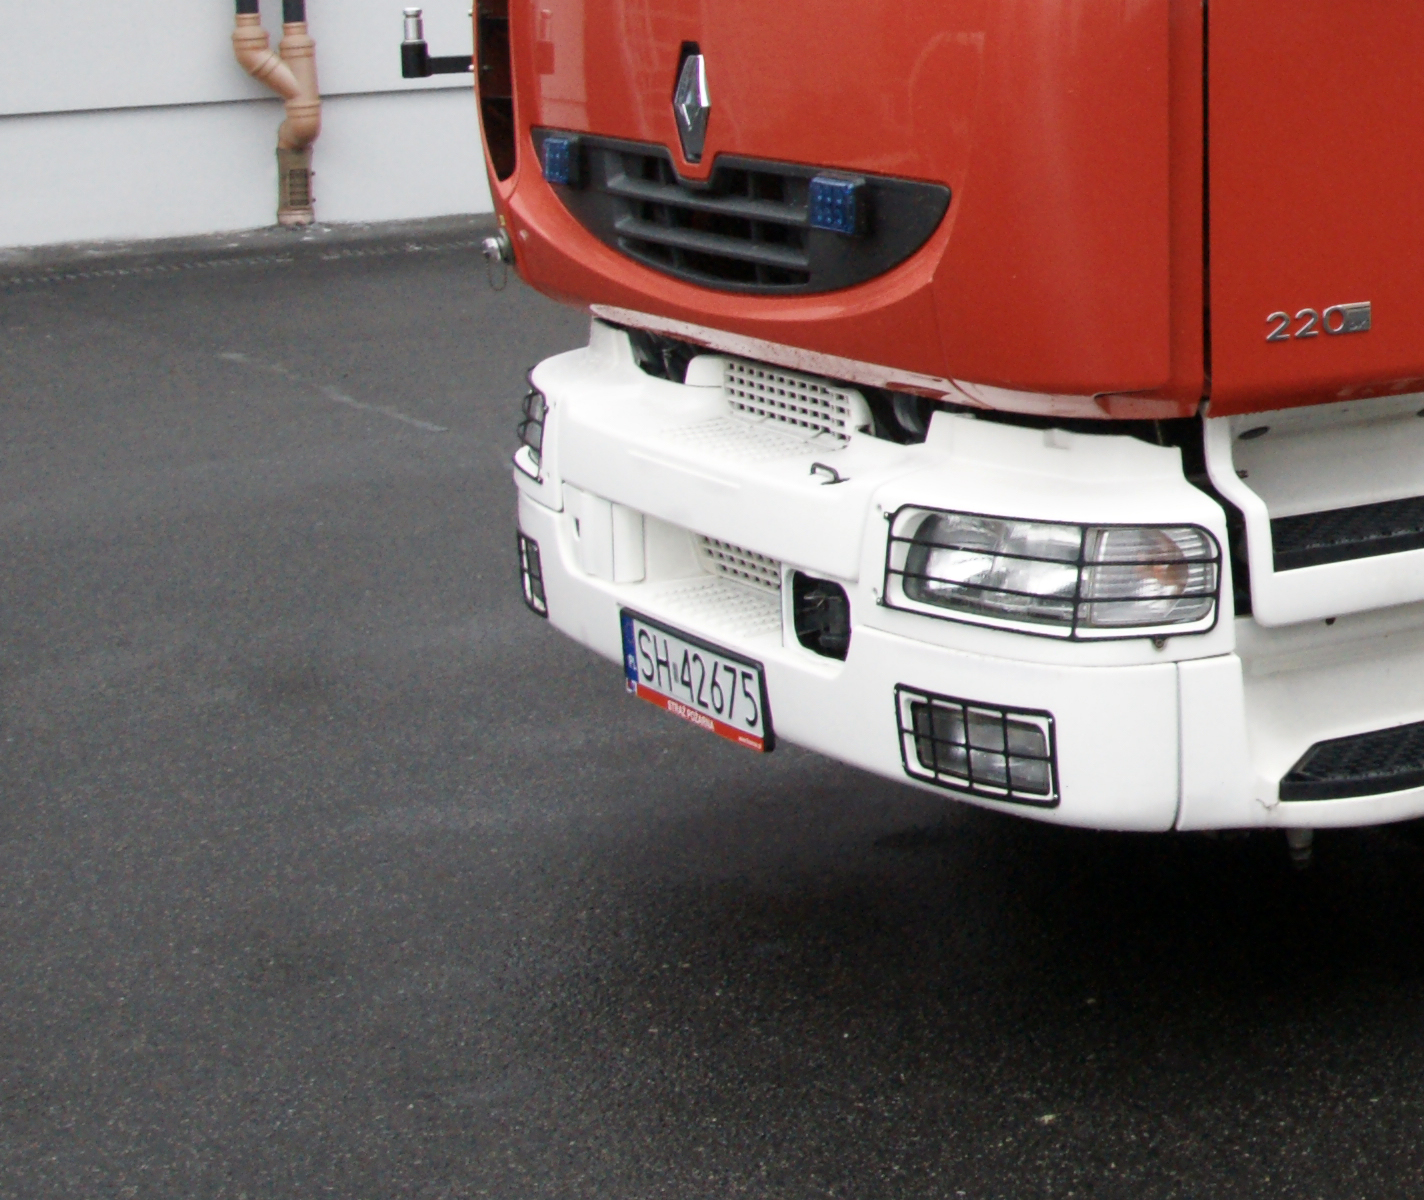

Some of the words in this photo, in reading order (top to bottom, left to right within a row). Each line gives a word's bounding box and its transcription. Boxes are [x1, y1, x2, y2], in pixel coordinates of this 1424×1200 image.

[1266, 304, 1346, 341] 220
[638, 629, 673, 692] SH
[681, 649, 759, 727] 42675
